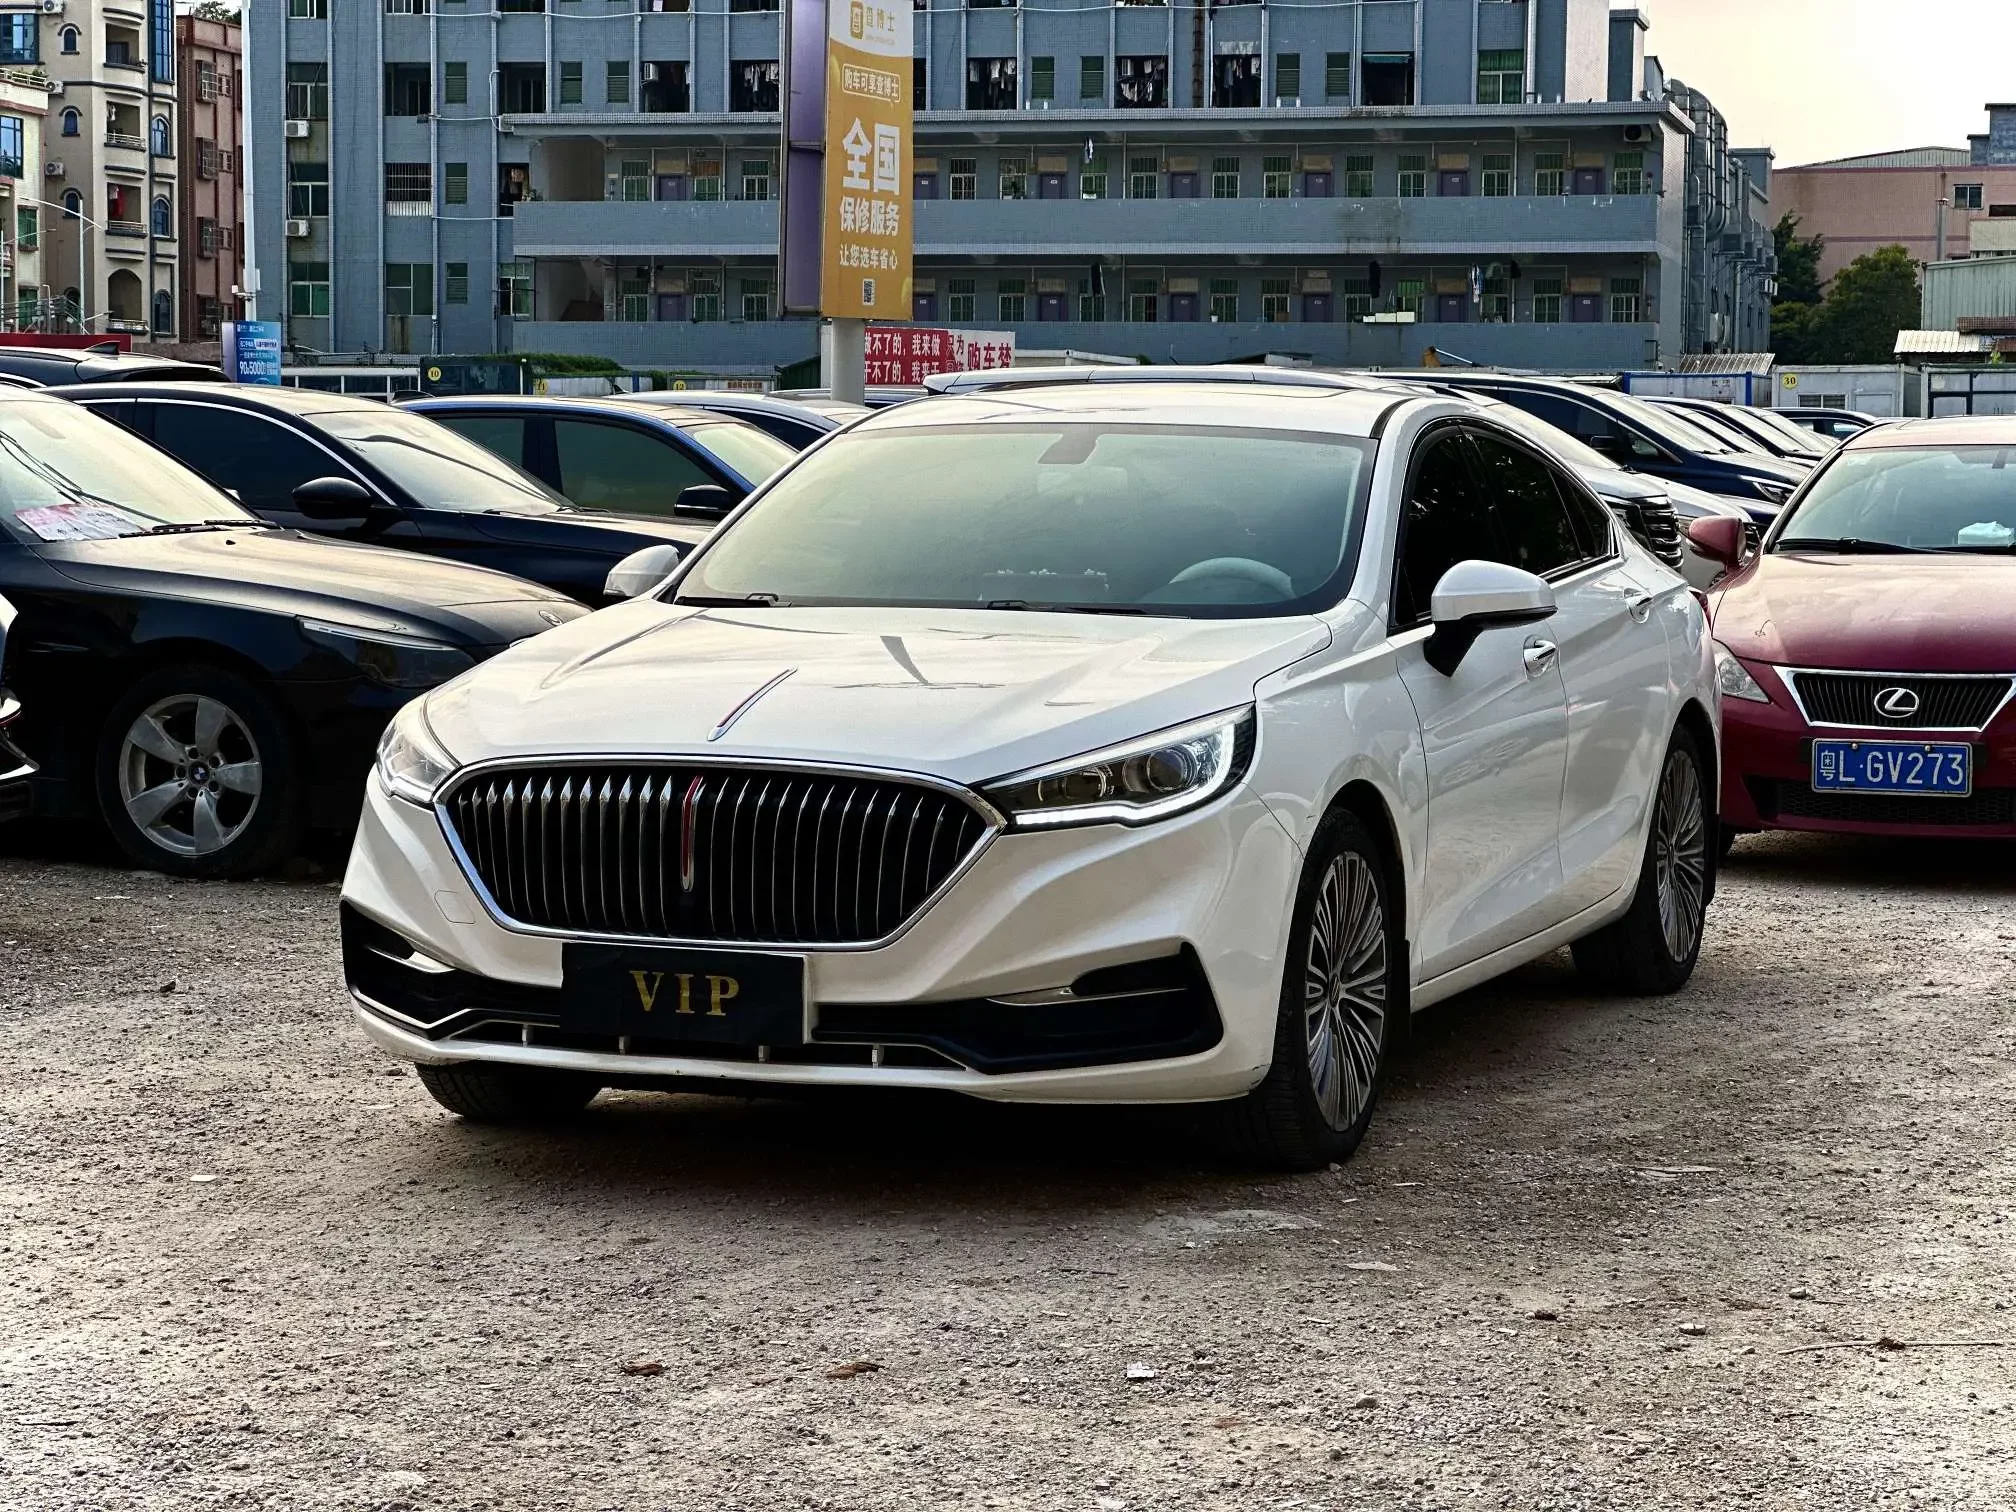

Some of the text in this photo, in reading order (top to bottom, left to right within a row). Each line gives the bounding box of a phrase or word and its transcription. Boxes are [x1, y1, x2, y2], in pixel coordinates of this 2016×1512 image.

[844, 68, 899, 97] 购车可享查博士
[842, 117, 900, 196] 全国
[840, 195, 900, 236] 保修服务
[840, 243, 898, 270] 让您选车省心
[946, 334, 964, 355] 只为
[967, 342, 1012, 371] 购车梦
[1783, 376, 1797, 385] 30
[1820, 750, 1964, 786] 粤L·GV273
[629, 970, 740, 1016] VIP
